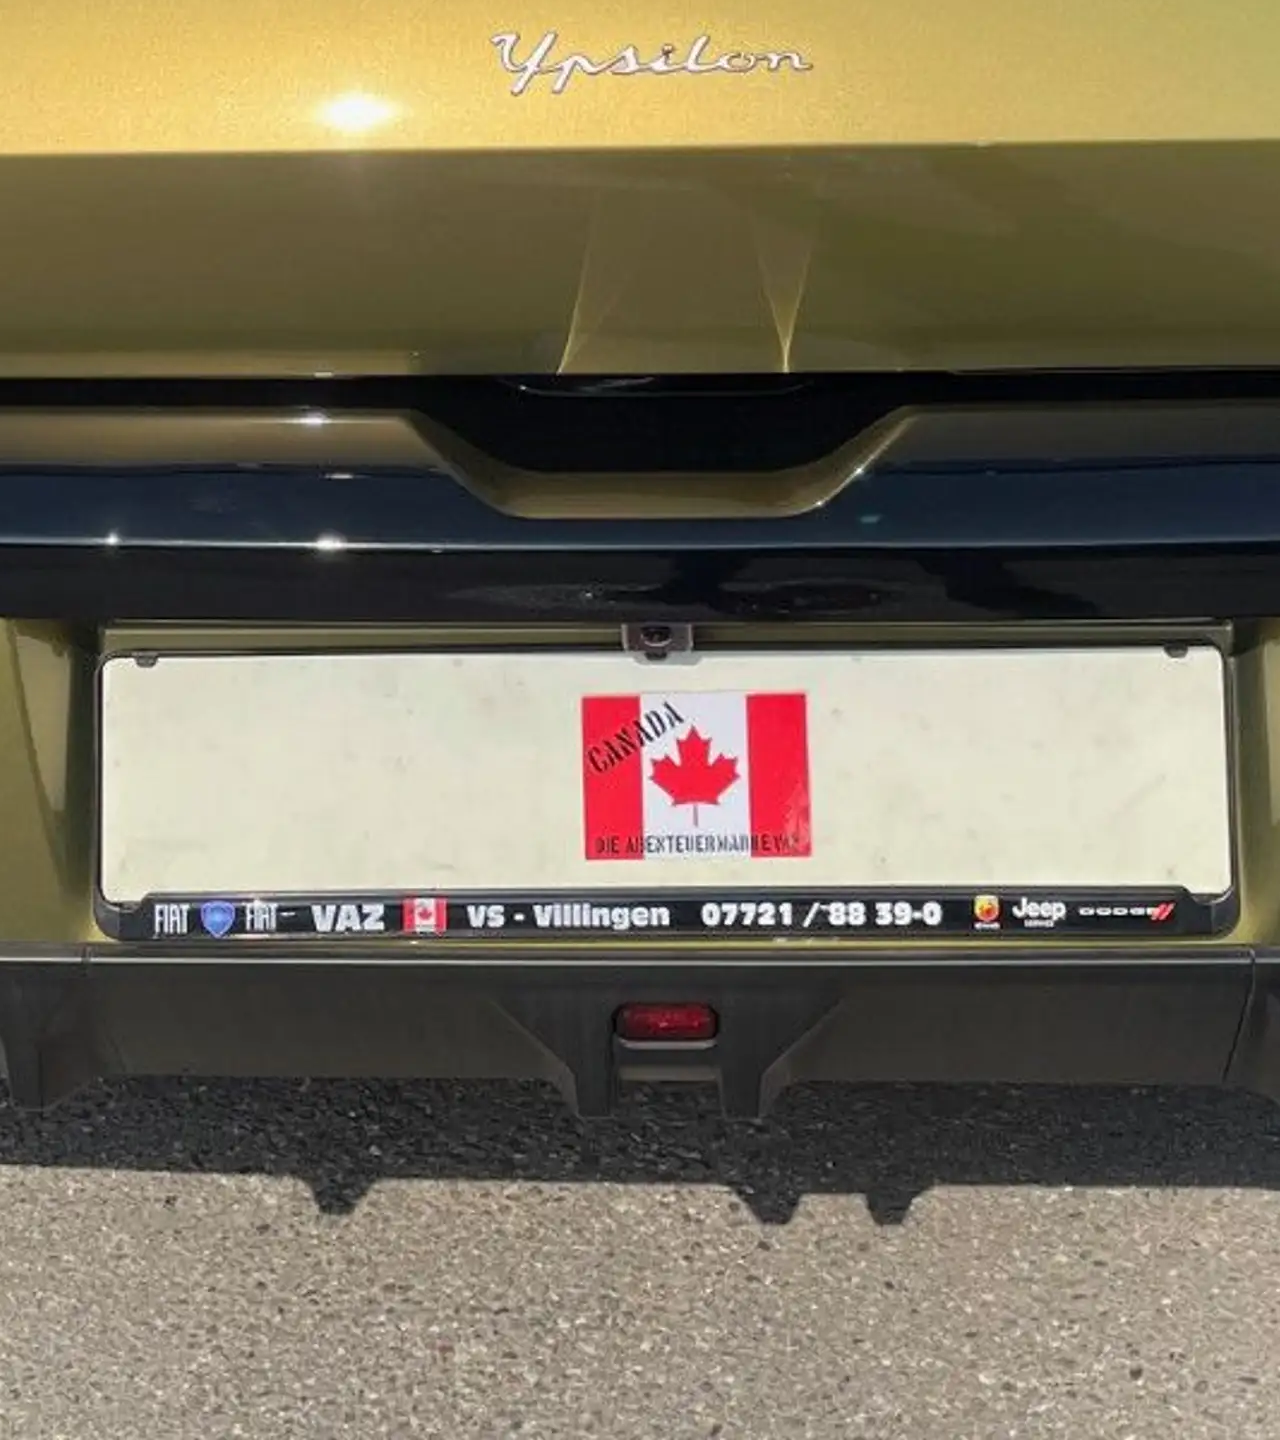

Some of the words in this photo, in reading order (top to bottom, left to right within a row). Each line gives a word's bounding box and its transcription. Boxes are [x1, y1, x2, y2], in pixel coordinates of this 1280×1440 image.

[490, 31, 814, 96] Ypsilon
[587, 700, 685, 774] CANADA
[154, 904, 190, 935] FIAT
[242, 901, 278, 932] FIAT
[311, 904, 385, 933] VAZ
[466, 905, 505, 929] VS
[534, 904, 670, 928] Villingen
[701, 902, 793, 927] 07721
[827, 901, 867, 926] 88
[874, 901, 943, 927] 39-0
[1012, 897, 1066, 921] Jeep
